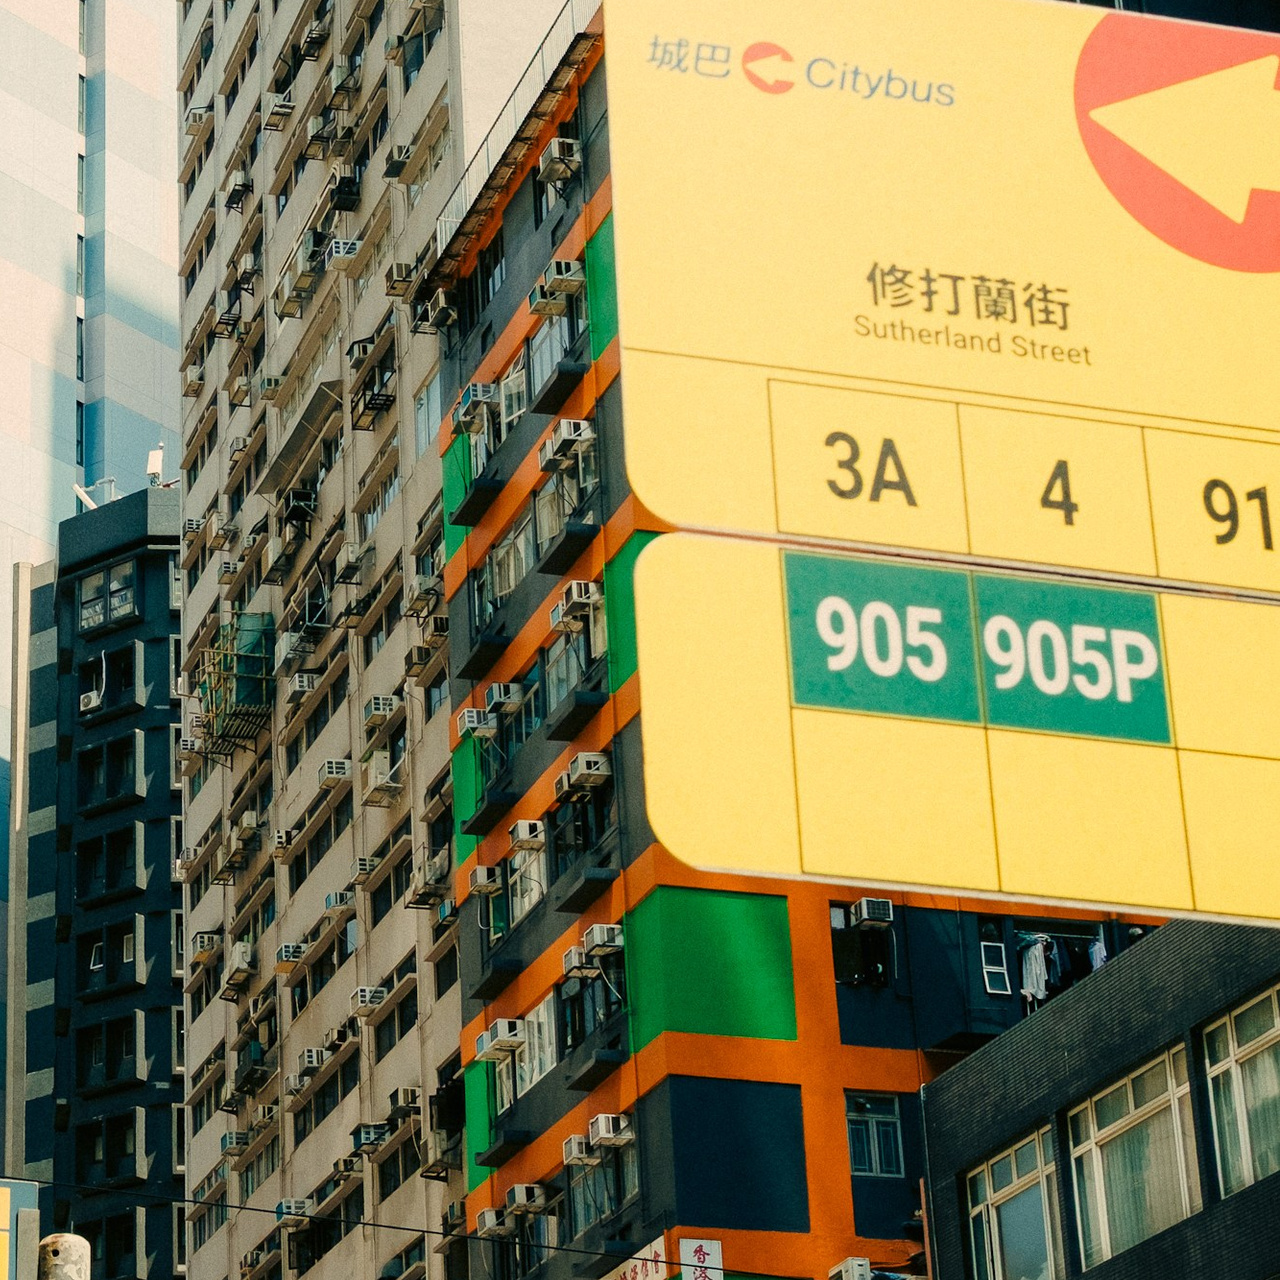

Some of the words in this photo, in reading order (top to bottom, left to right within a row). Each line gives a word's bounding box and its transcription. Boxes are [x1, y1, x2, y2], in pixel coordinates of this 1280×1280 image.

[647, 34, 731, 79] 城巴
[805, 55, 956, 107] Citybus
[866, 260, 1070, 331] 修打蘭街
[854, 315, 1002, 356] Sutherland
[1011, 334, 1092, 366] Street
[823, 431, 919, 508] 3A
[1039, 459, 1079, 526] 4
[815, 595, 948, 682] 905
[983, 614, 1159, 704] 905P
